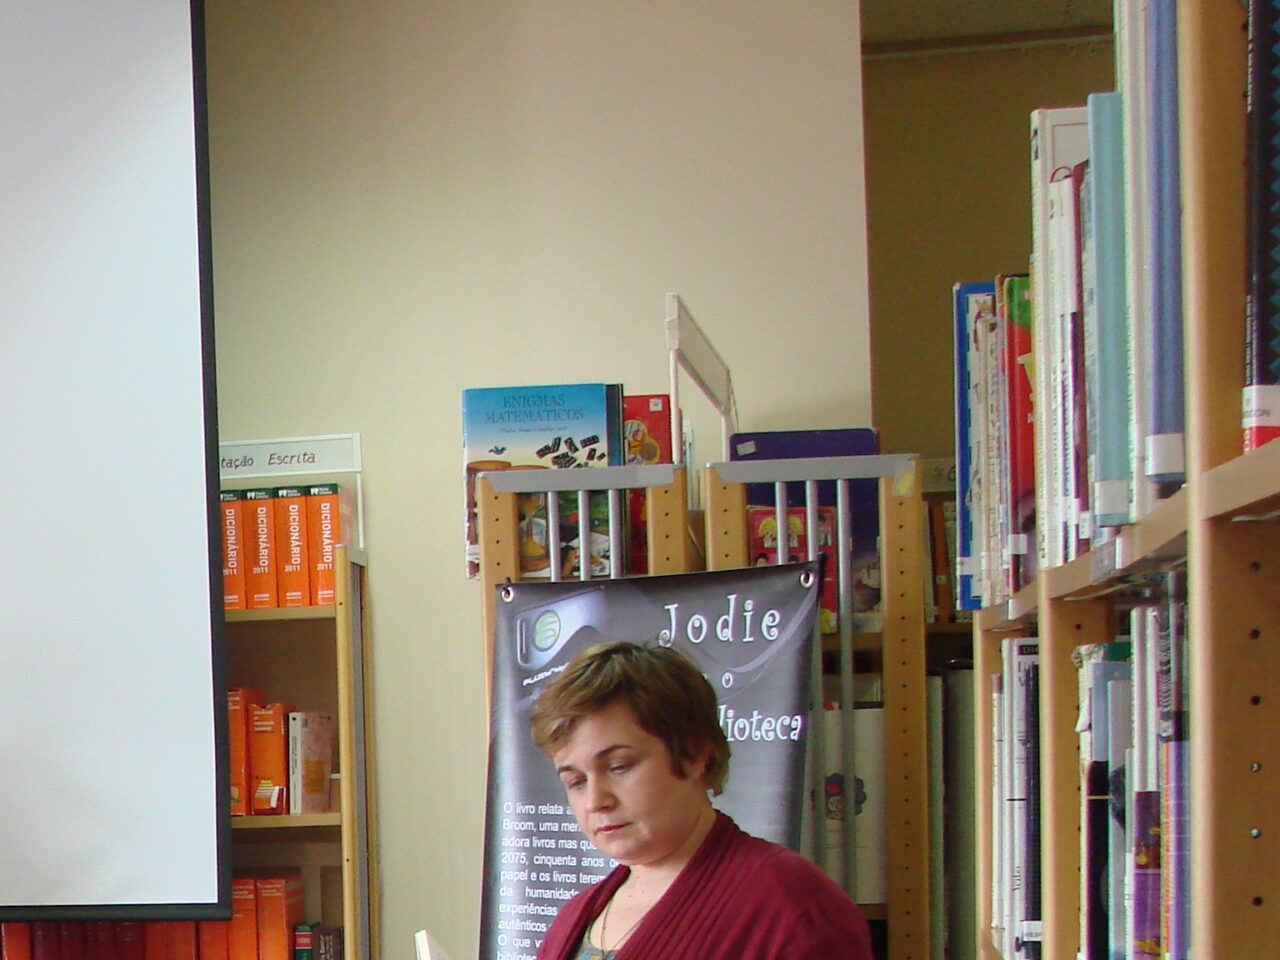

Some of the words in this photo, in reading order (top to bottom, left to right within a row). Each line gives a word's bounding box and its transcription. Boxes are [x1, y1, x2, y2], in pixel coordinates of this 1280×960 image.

[503, 394, 566, 408] ENIGMAS
[268, 452, 316, 466] Escrita
[225, 508, 239, 568] DICIONÁRIO
[257, 506, 271, 567] DICIONÁRIO
[289, 504, 303, 565] DICIONÁRIO
[320, 502, 334, 563] DICIONÁRIO
[658, 594, 781, 648] Jodie
[722, 672, 734, 689] o
[503, 802, 513, 813] O
[516, 802, 535, 814] livro
[538, 803, 563, 815] relata
[502, 819, 537, 832] Broom,
[539, 822, 559, 832] uma
[501, 836, 530, 847] adora
[532, 836, 556, 848] livros
[558, 840, 578, 849] mas
[501, 852, 529, 865] 2075,
[533, 853, 577, 867] cinquenta
[581, 858, 605, 867] anos
[500, 870, 528, 882] papel
[530, 873, 537, 881] e
[539, 873, 550, 882] os
[552, 871, 577, 883] livros
[499, 886, 513, 896] da
[498, 902, 558, 917] experiências
[498, 918, 547, 932] autênticos
[498, 934, 507, 946] O
[513, 938, 531, 949] que
